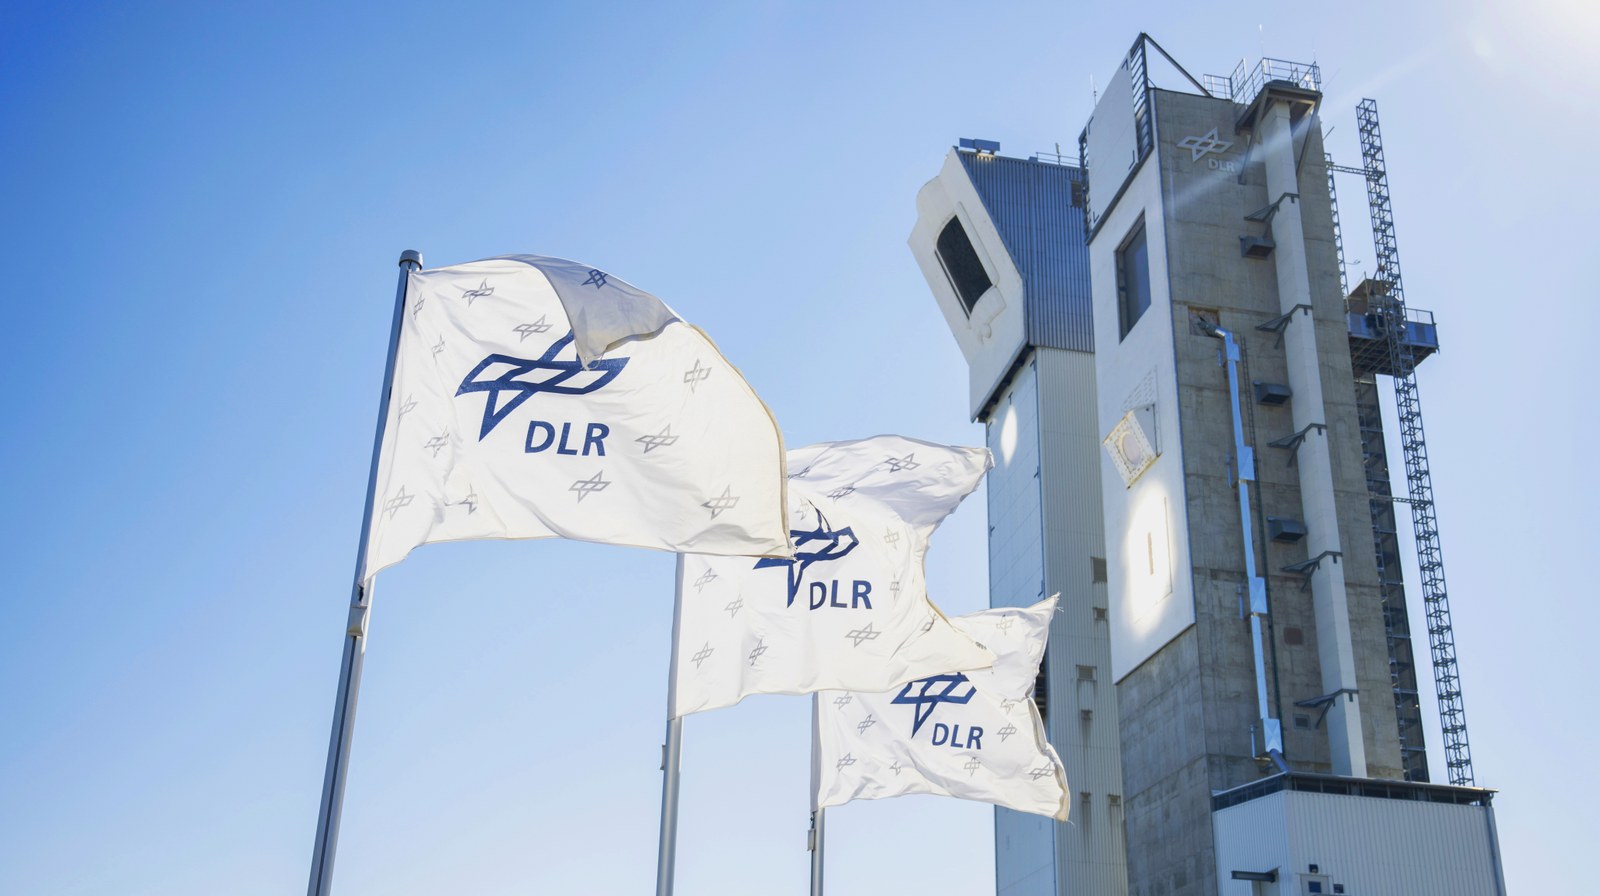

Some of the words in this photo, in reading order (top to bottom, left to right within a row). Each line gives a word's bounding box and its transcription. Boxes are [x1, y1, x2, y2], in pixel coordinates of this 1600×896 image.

[1208, 158, 1236, 173] DLR
[525, 420, 610, 456] DLR
[809, 579, 873, 611] DLR
[931, 722, 984, 750] DLR
